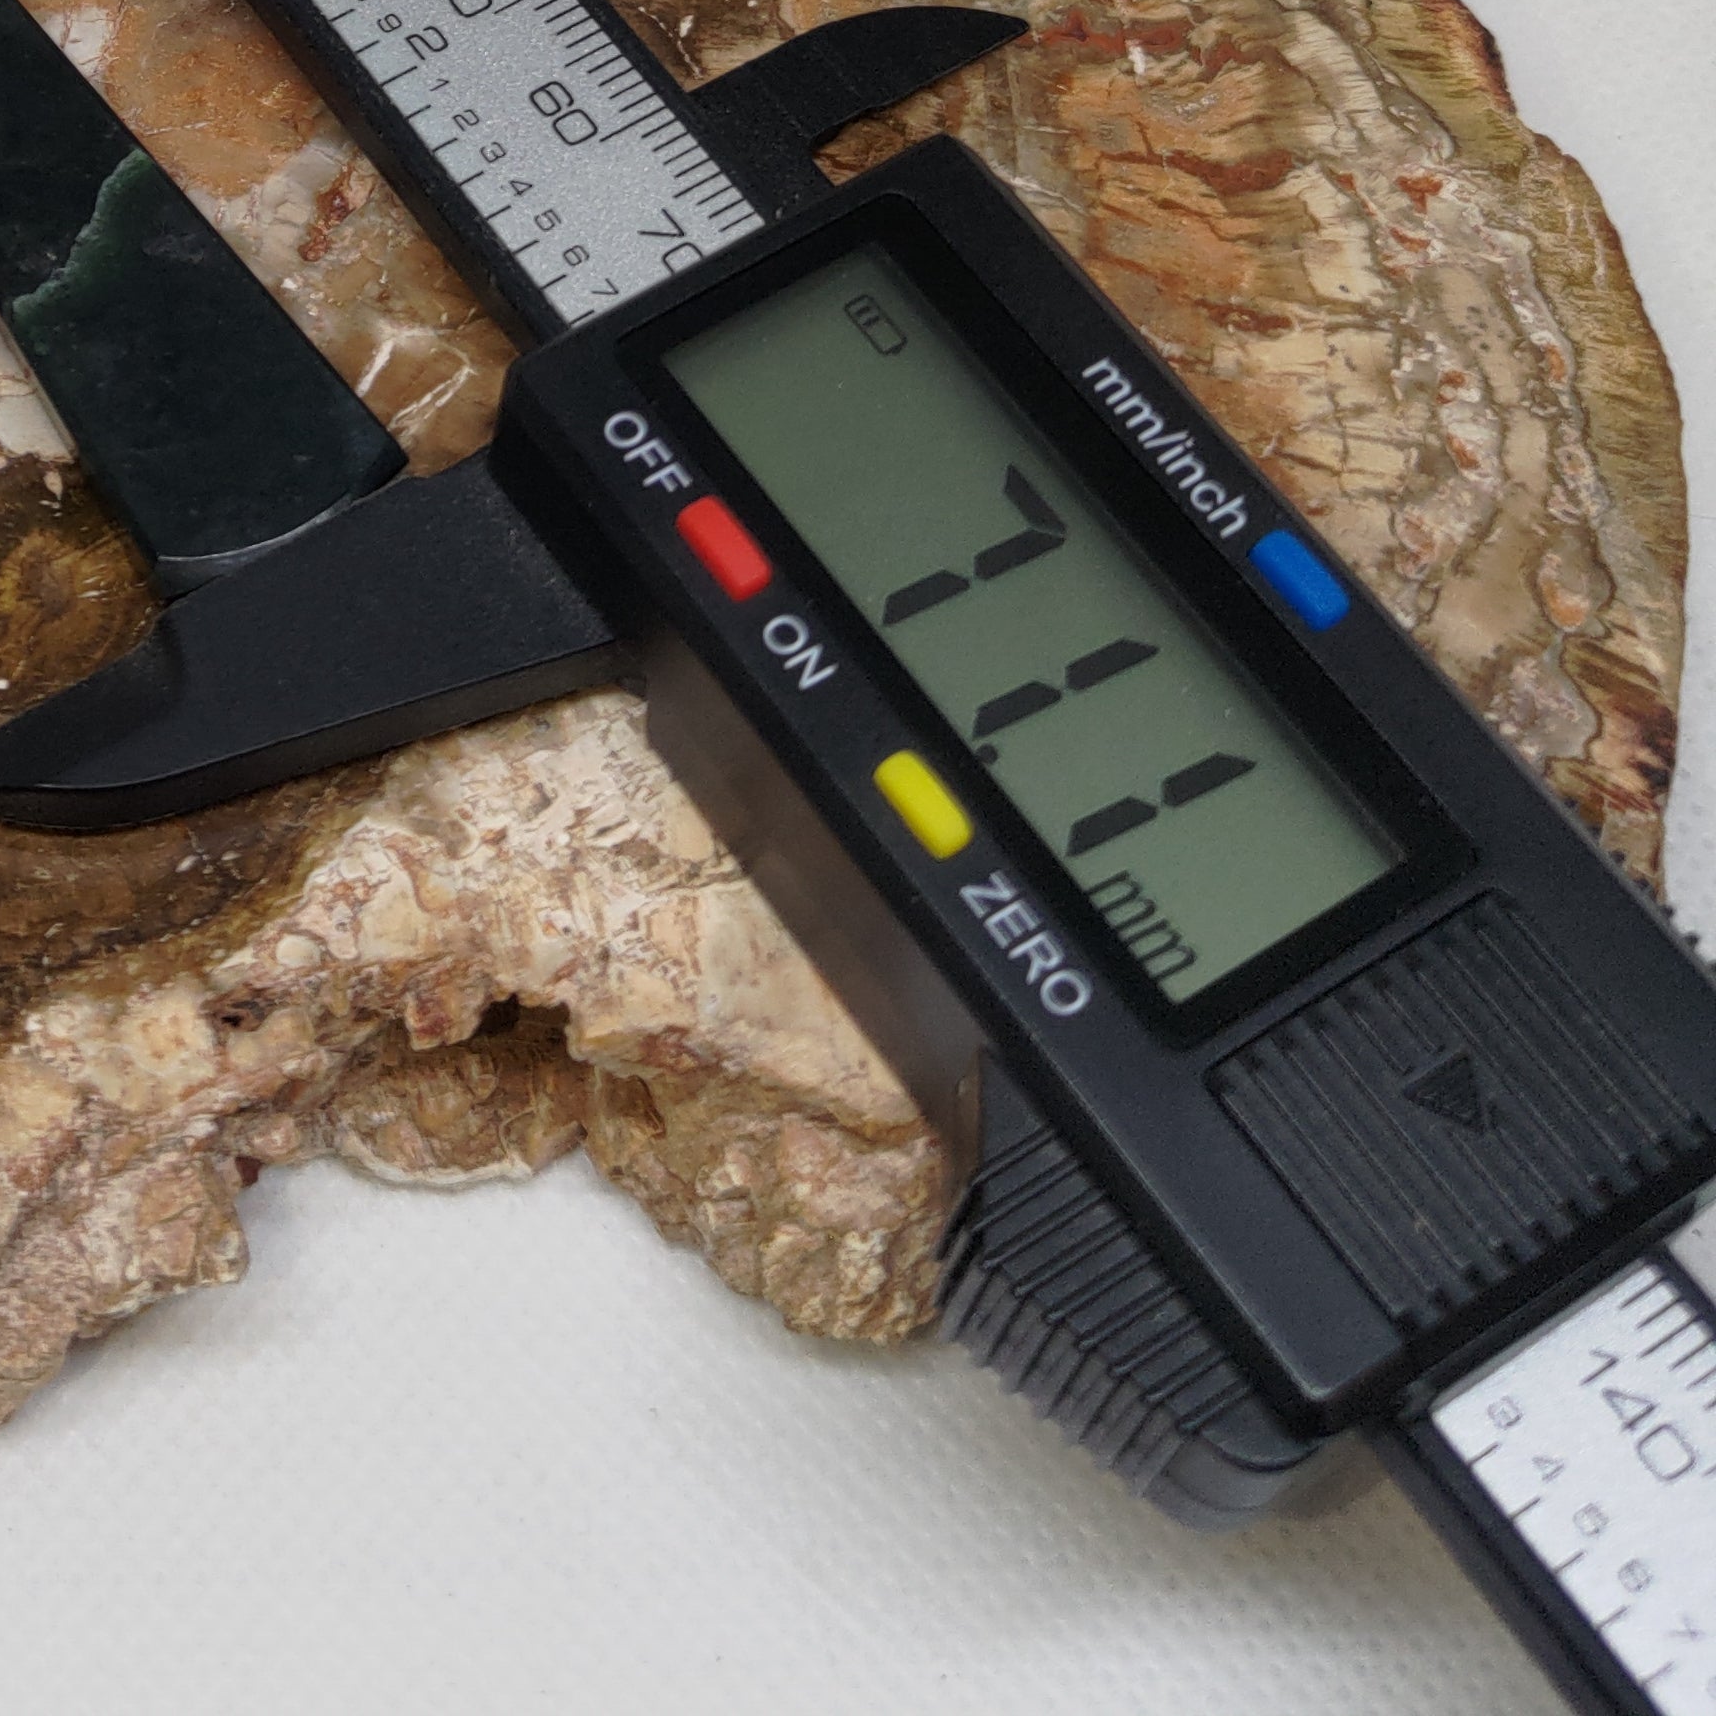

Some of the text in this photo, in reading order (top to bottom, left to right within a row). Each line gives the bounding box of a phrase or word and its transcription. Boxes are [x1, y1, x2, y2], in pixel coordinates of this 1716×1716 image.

[376, 14, 404, 33] 9
[405, 27, 450, 61] 2
[429, 79, 451, 92] 1
[453, 110, 481, 132] 2
[479, 142, 508, 164] 3
[510, 180, 534, 196] 4
[534, 210, 563, 232] 5
[562, 246, 591, 267] 6
[592, 279, 620, 296] 7
[529, 81, 599, 146] 60
[603, 409, 692, 497] OFF
[1082, 356, 1251, 541] mm/inch
[761, 614, 839, 692] ON
[884, 463, 1257, 988] 71.1 mm
[959, 870, 1092, 1017] ZERO
[1579, 1347, 1698, 1483] 140
